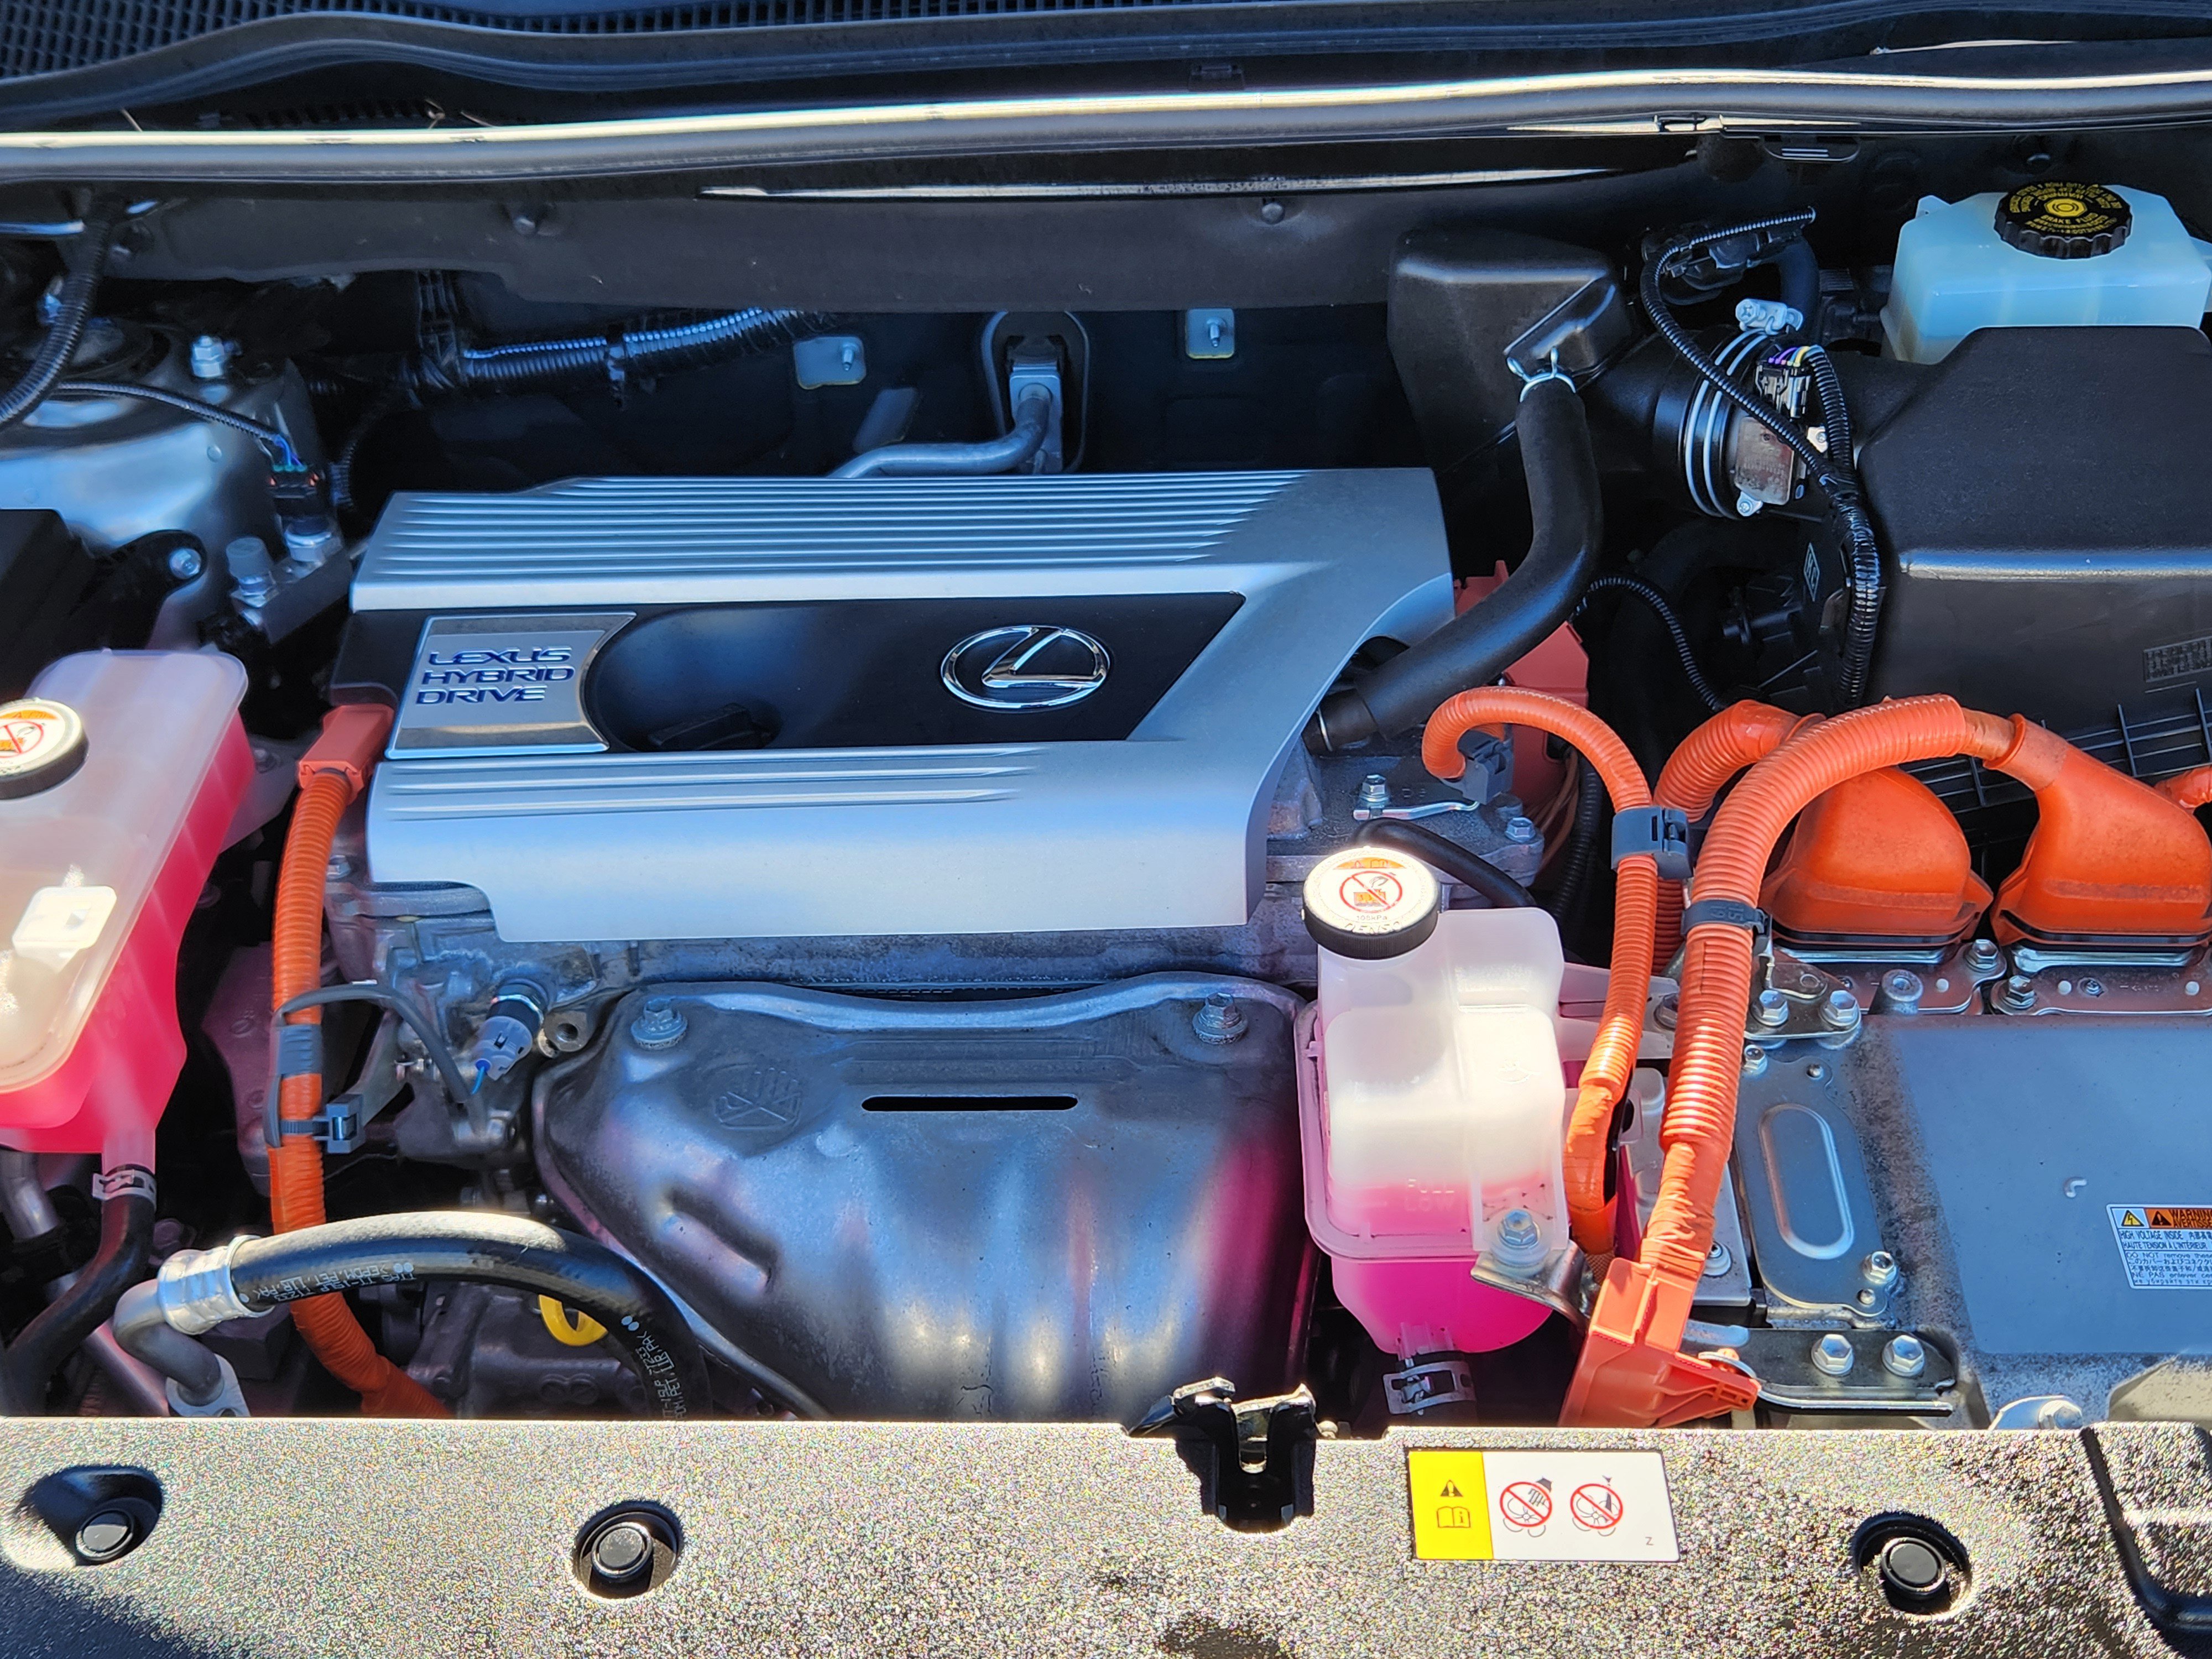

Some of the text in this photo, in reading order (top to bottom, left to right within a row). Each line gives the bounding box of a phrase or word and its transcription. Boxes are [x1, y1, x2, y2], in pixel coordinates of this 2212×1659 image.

[2040, 212, 2099, 224] BRAKE FLUID
[428, 646, 572, 666] LEXUS
[421, 665, 576, 685] HYBRID
[415, 685, 548, 705] DRIVE
[1344, 920, 1400, 935] DENSO
[2168, 1209, 2212, 1219] WARNIN
[2119, 1230, 2135, 1239] HIGH
[2136, 1230, 2163, 1239] VOLTAGE
